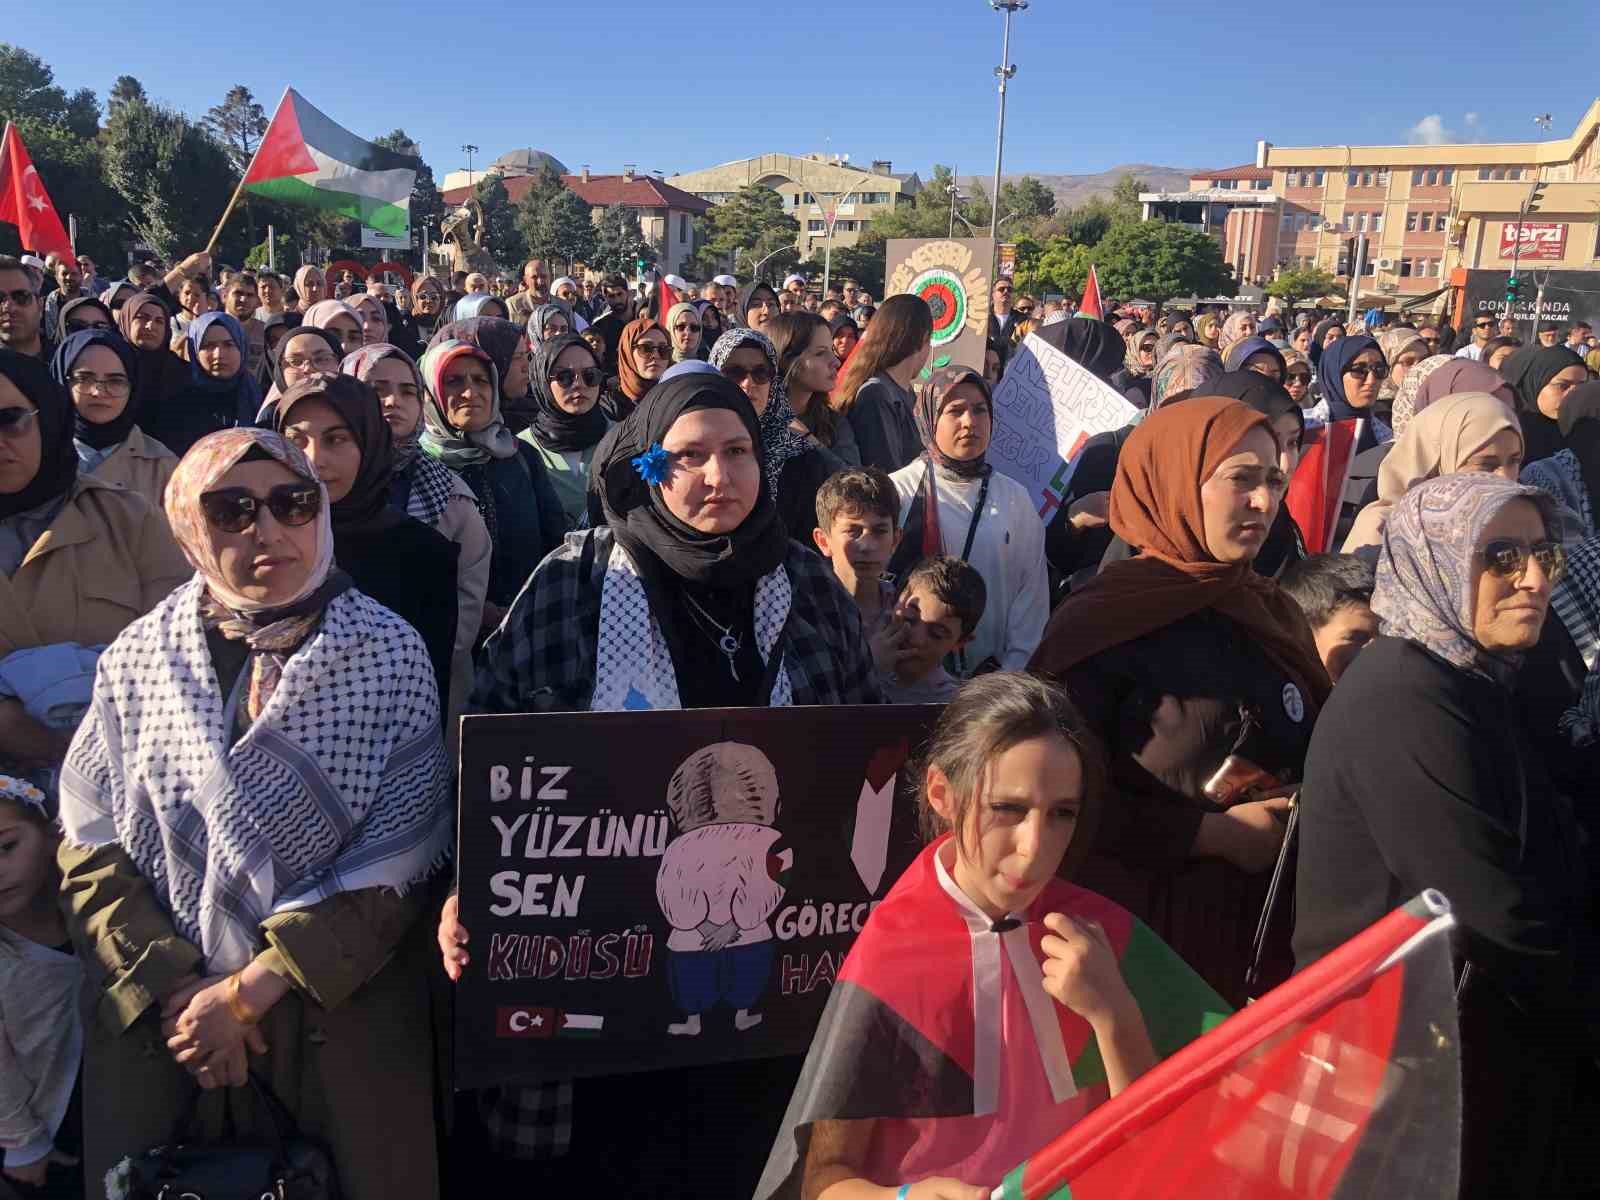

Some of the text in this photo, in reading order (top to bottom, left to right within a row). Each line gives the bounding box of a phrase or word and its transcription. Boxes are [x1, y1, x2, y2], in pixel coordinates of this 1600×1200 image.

[1504, 224, 1563, 241] terzi
[489, 756, 573, 802] BİZ
[490, 806, 668, 858] YÜZÜNÜ
[489, 870, 585, 918] SEN
[488, 924, 654, 981] KUDÜS'Ü
[782, 949, 847, 995] HA
